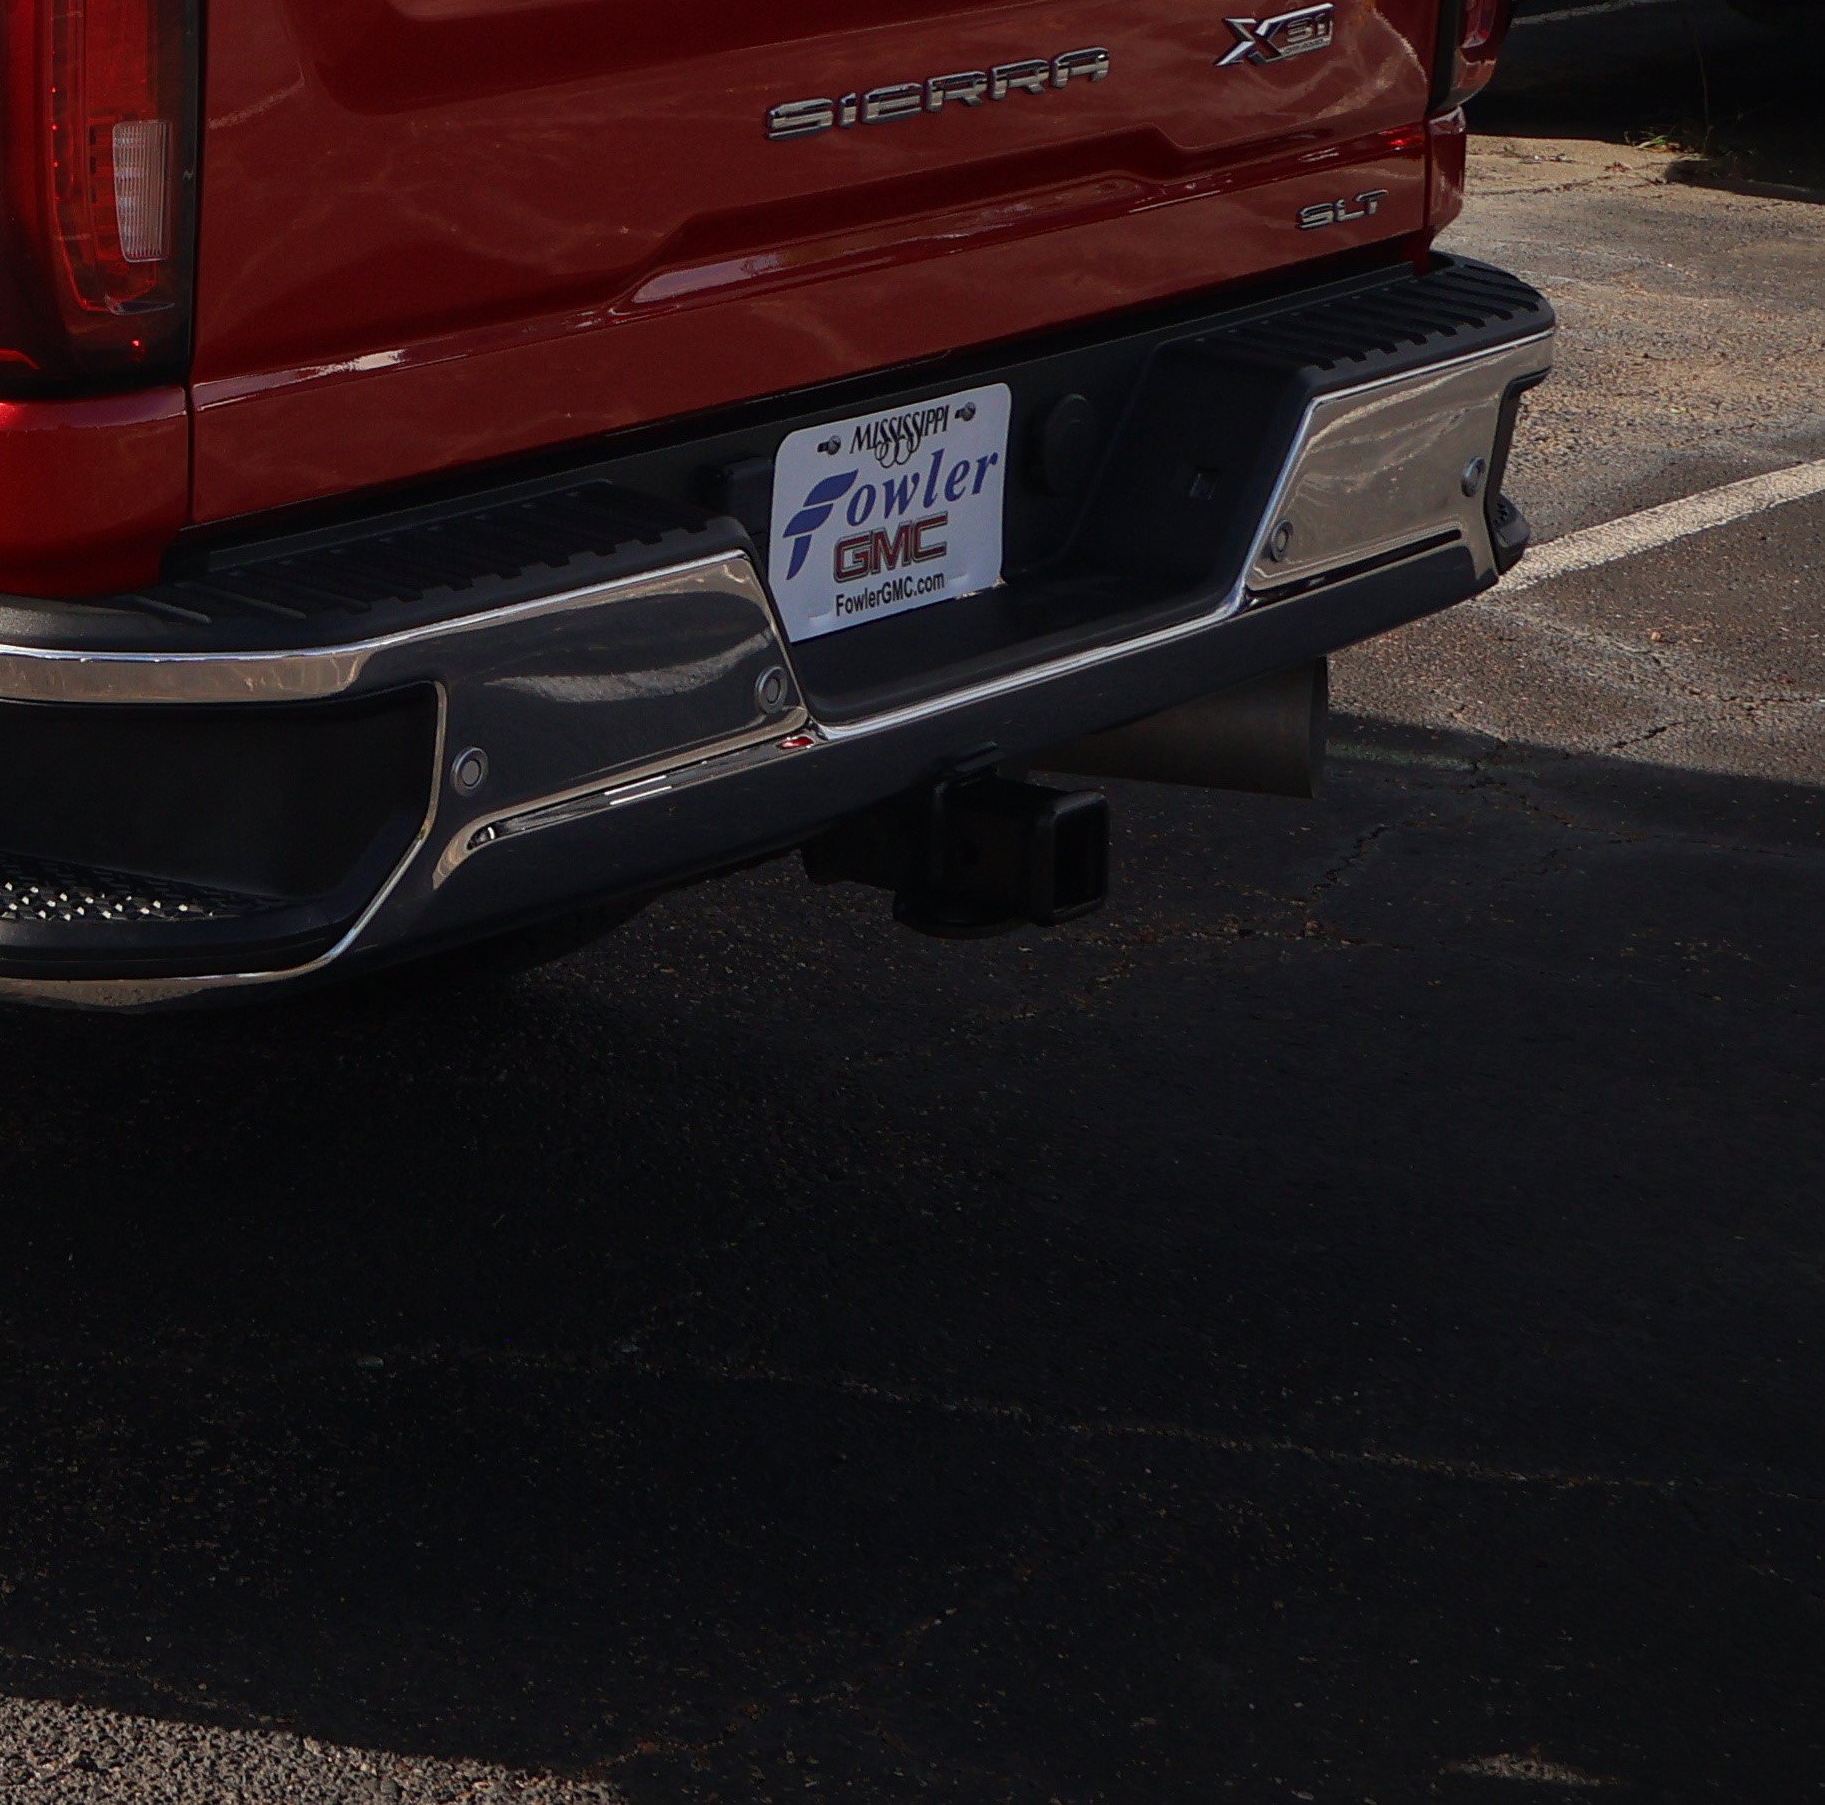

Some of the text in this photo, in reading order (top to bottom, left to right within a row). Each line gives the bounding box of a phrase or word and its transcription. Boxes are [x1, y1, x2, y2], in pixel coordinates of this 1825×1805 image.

[1212, 1, 1335, 67] X31
[765, 45, 1110, 142] SIERRA
[1297, 188, 1389, 231] SLT
[849, 404, 950, 469] MISSISSIPPI
[782, 447, 999, 581] Fowler
[833, 510, 949, 583] GMC
[835, 571, 945, 617] FowlerGMC.com
